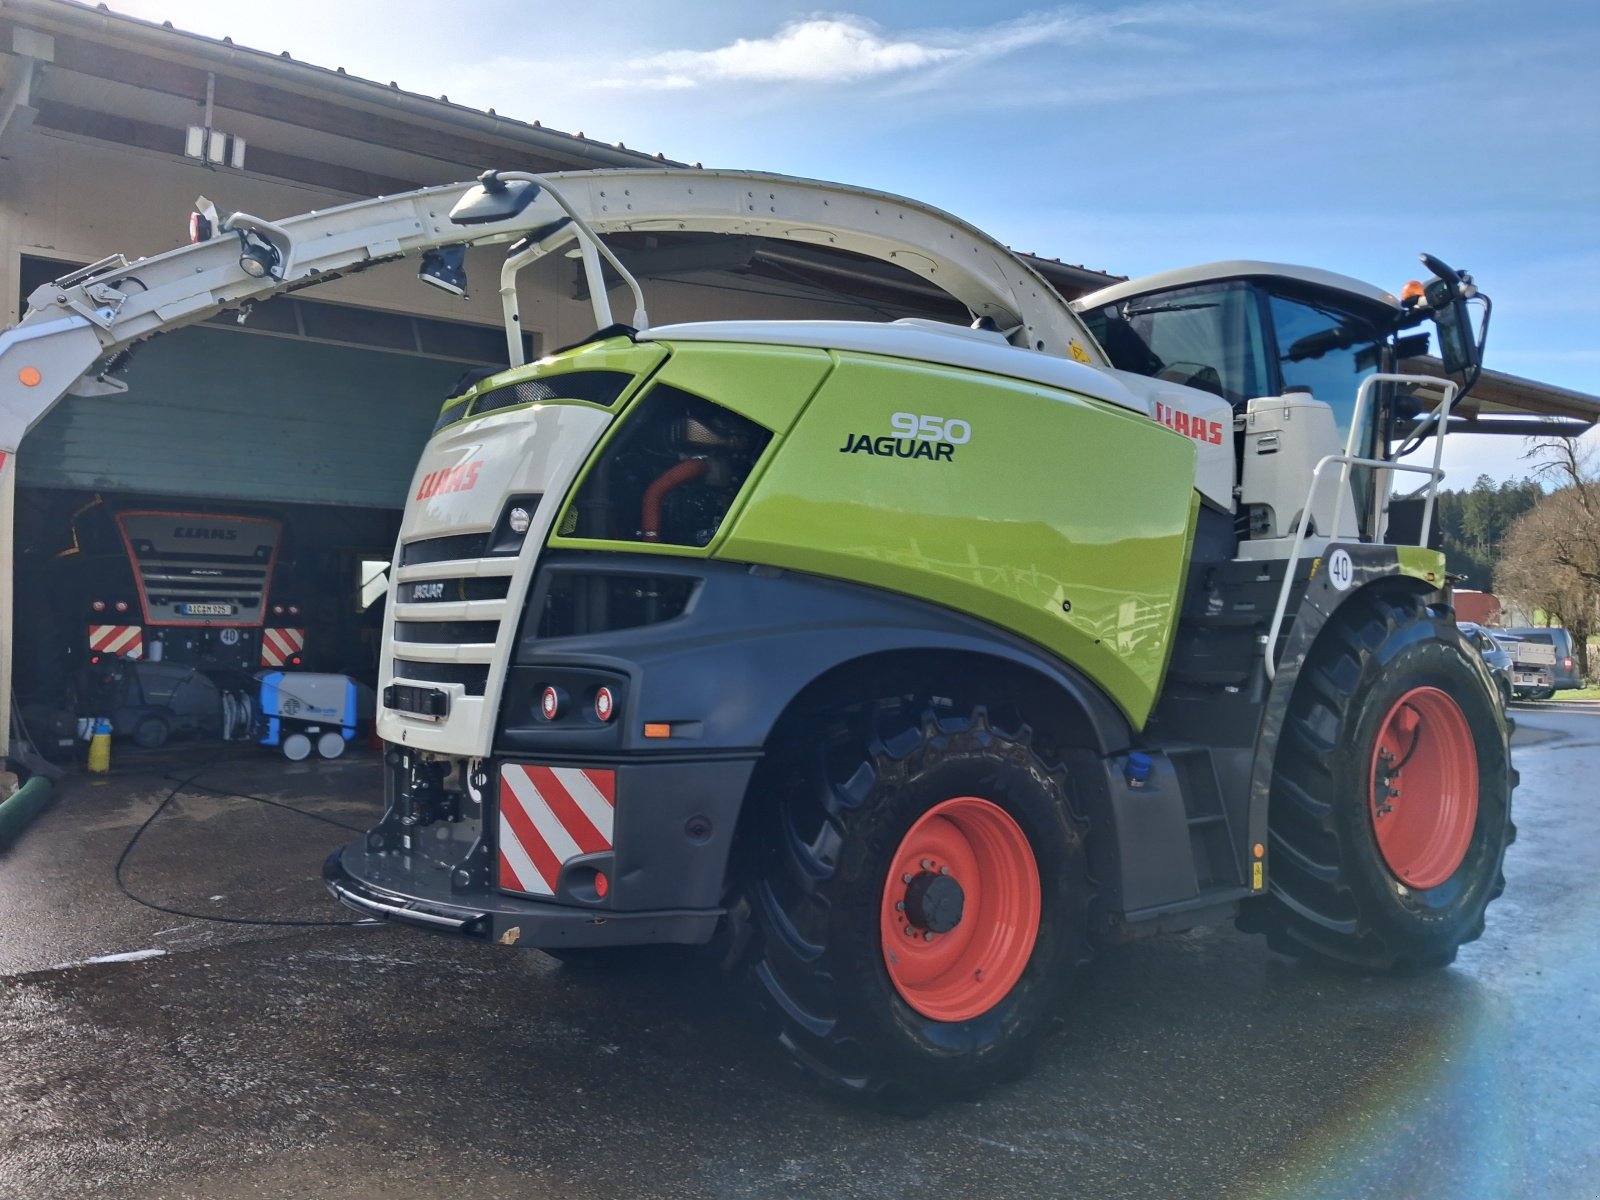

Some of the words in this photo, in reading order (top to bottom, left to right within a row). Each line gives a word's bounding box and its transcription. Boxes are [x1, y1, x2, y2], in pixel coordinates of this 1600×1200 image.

[891, 412, 971, 444] 950
[839, 434, 955, 462] JAGUAR
[416, 460, 484, 501] CLAAS
[174, 527, 237, 540] CLAAS
[1333, 556, 1348, 582] 40
[413, 583, 444, 599] JAGUAR
[223, 630, 236, 641] 40
